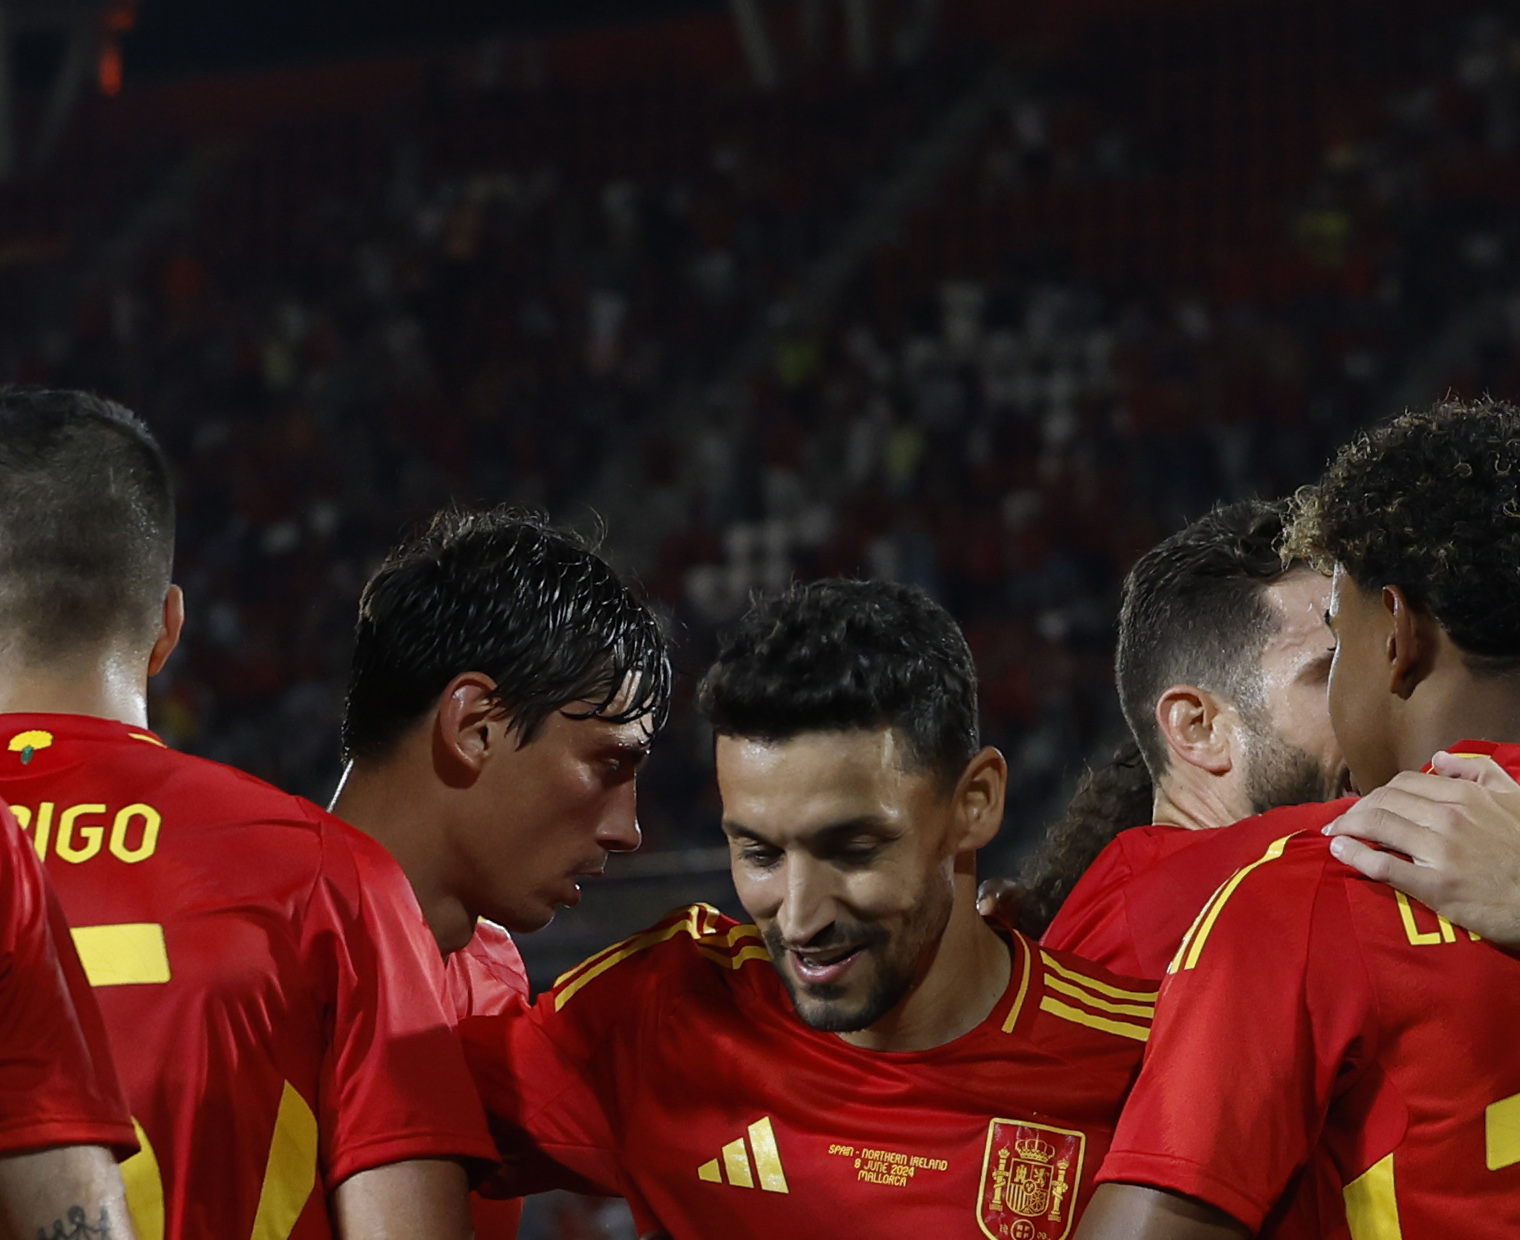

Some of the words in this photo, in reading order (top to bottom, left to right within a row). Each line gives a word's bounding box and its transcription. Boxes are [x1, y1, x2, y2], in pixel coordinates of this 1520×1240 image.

[828, 1144, 854, 1157] SPAIN
[861, 1148, 908, 1165] NORTHERN
[909, 1155, 948, 1171] IRELAND
[854, 1158, 861, 1169] 8
[863, 1161, 888, 1173] JUNE
[890, 1164, 915, 1178] 2024
[857, 1169, 907, 1187] MALLORCA
